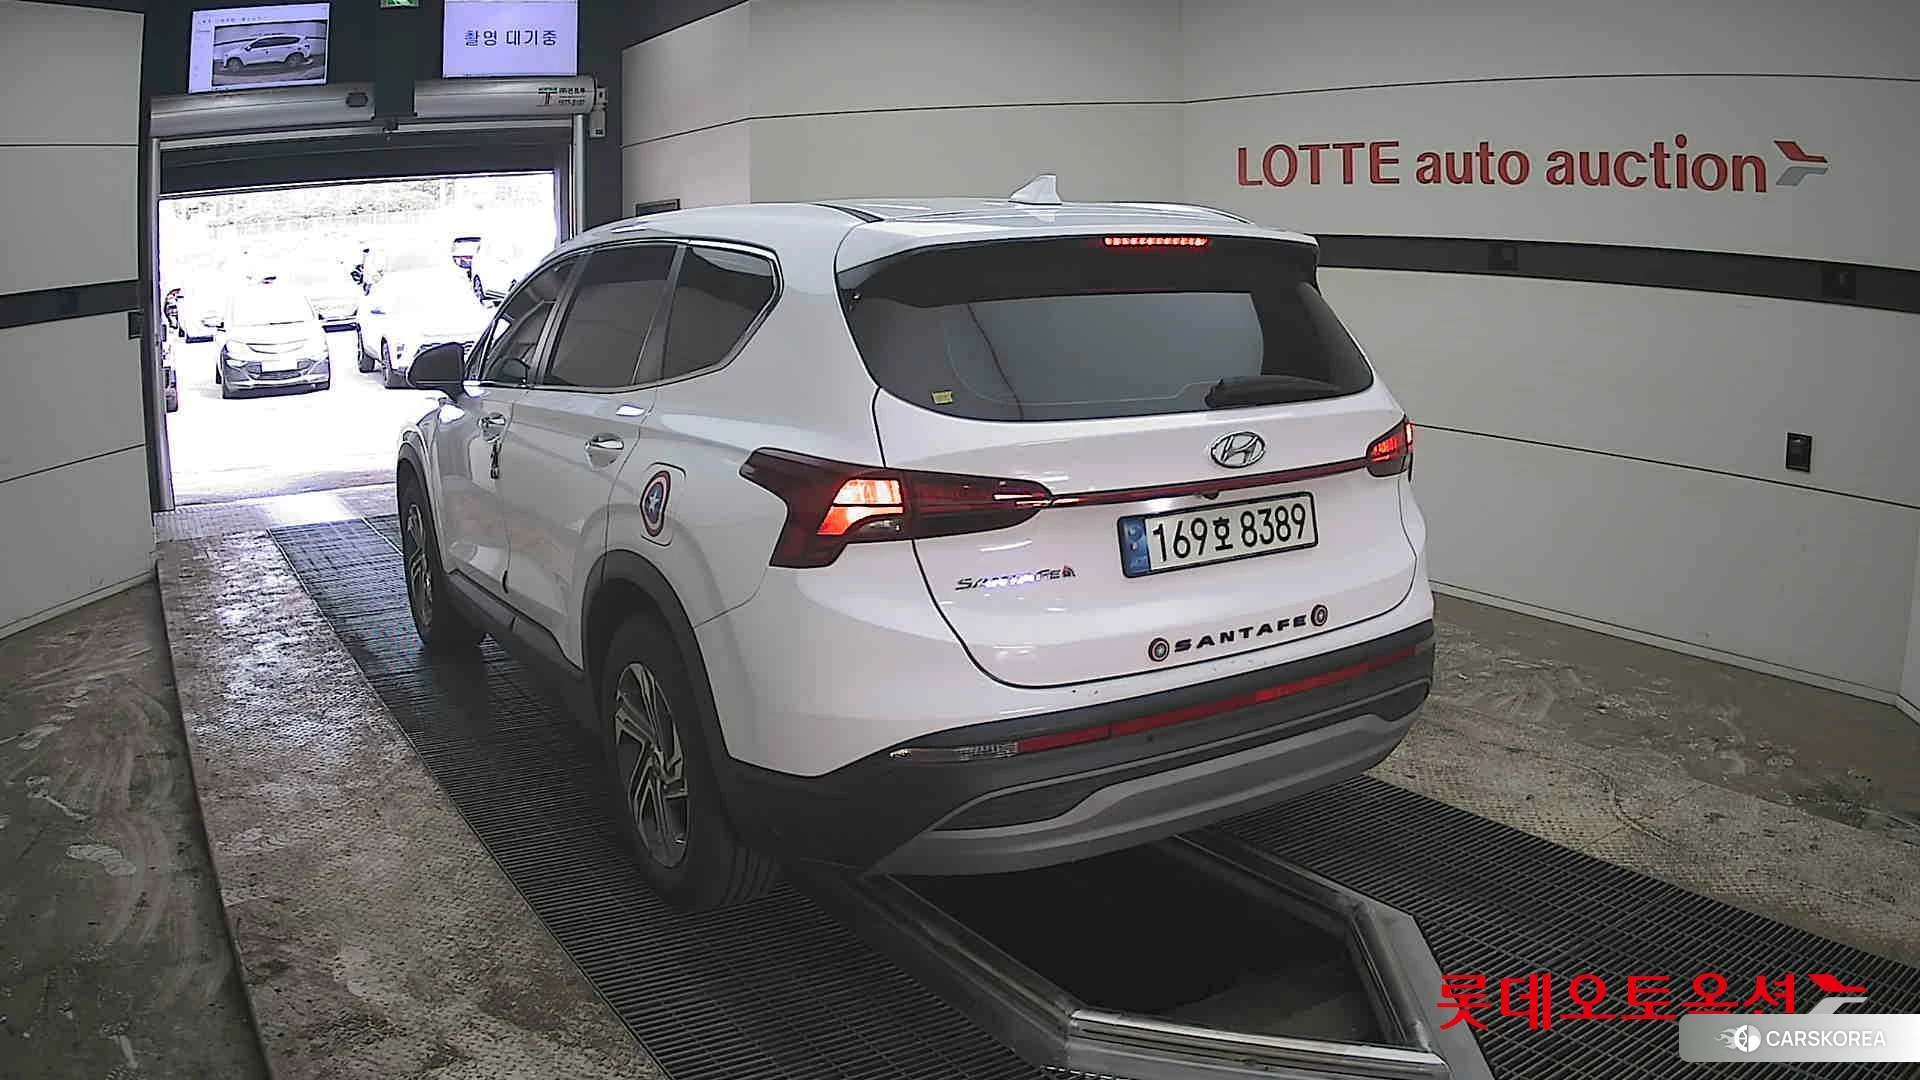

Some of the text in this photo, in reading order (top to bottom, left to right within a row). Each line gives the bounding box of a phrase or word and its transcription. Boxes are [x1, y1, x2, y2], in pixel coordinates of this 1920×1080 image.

[463, 29, 557, 47] 촬영 대기중
[1238, 134, 1767, 193] LOTTE auto auction
[1174, 614, 1307, 653] SANTAFE
